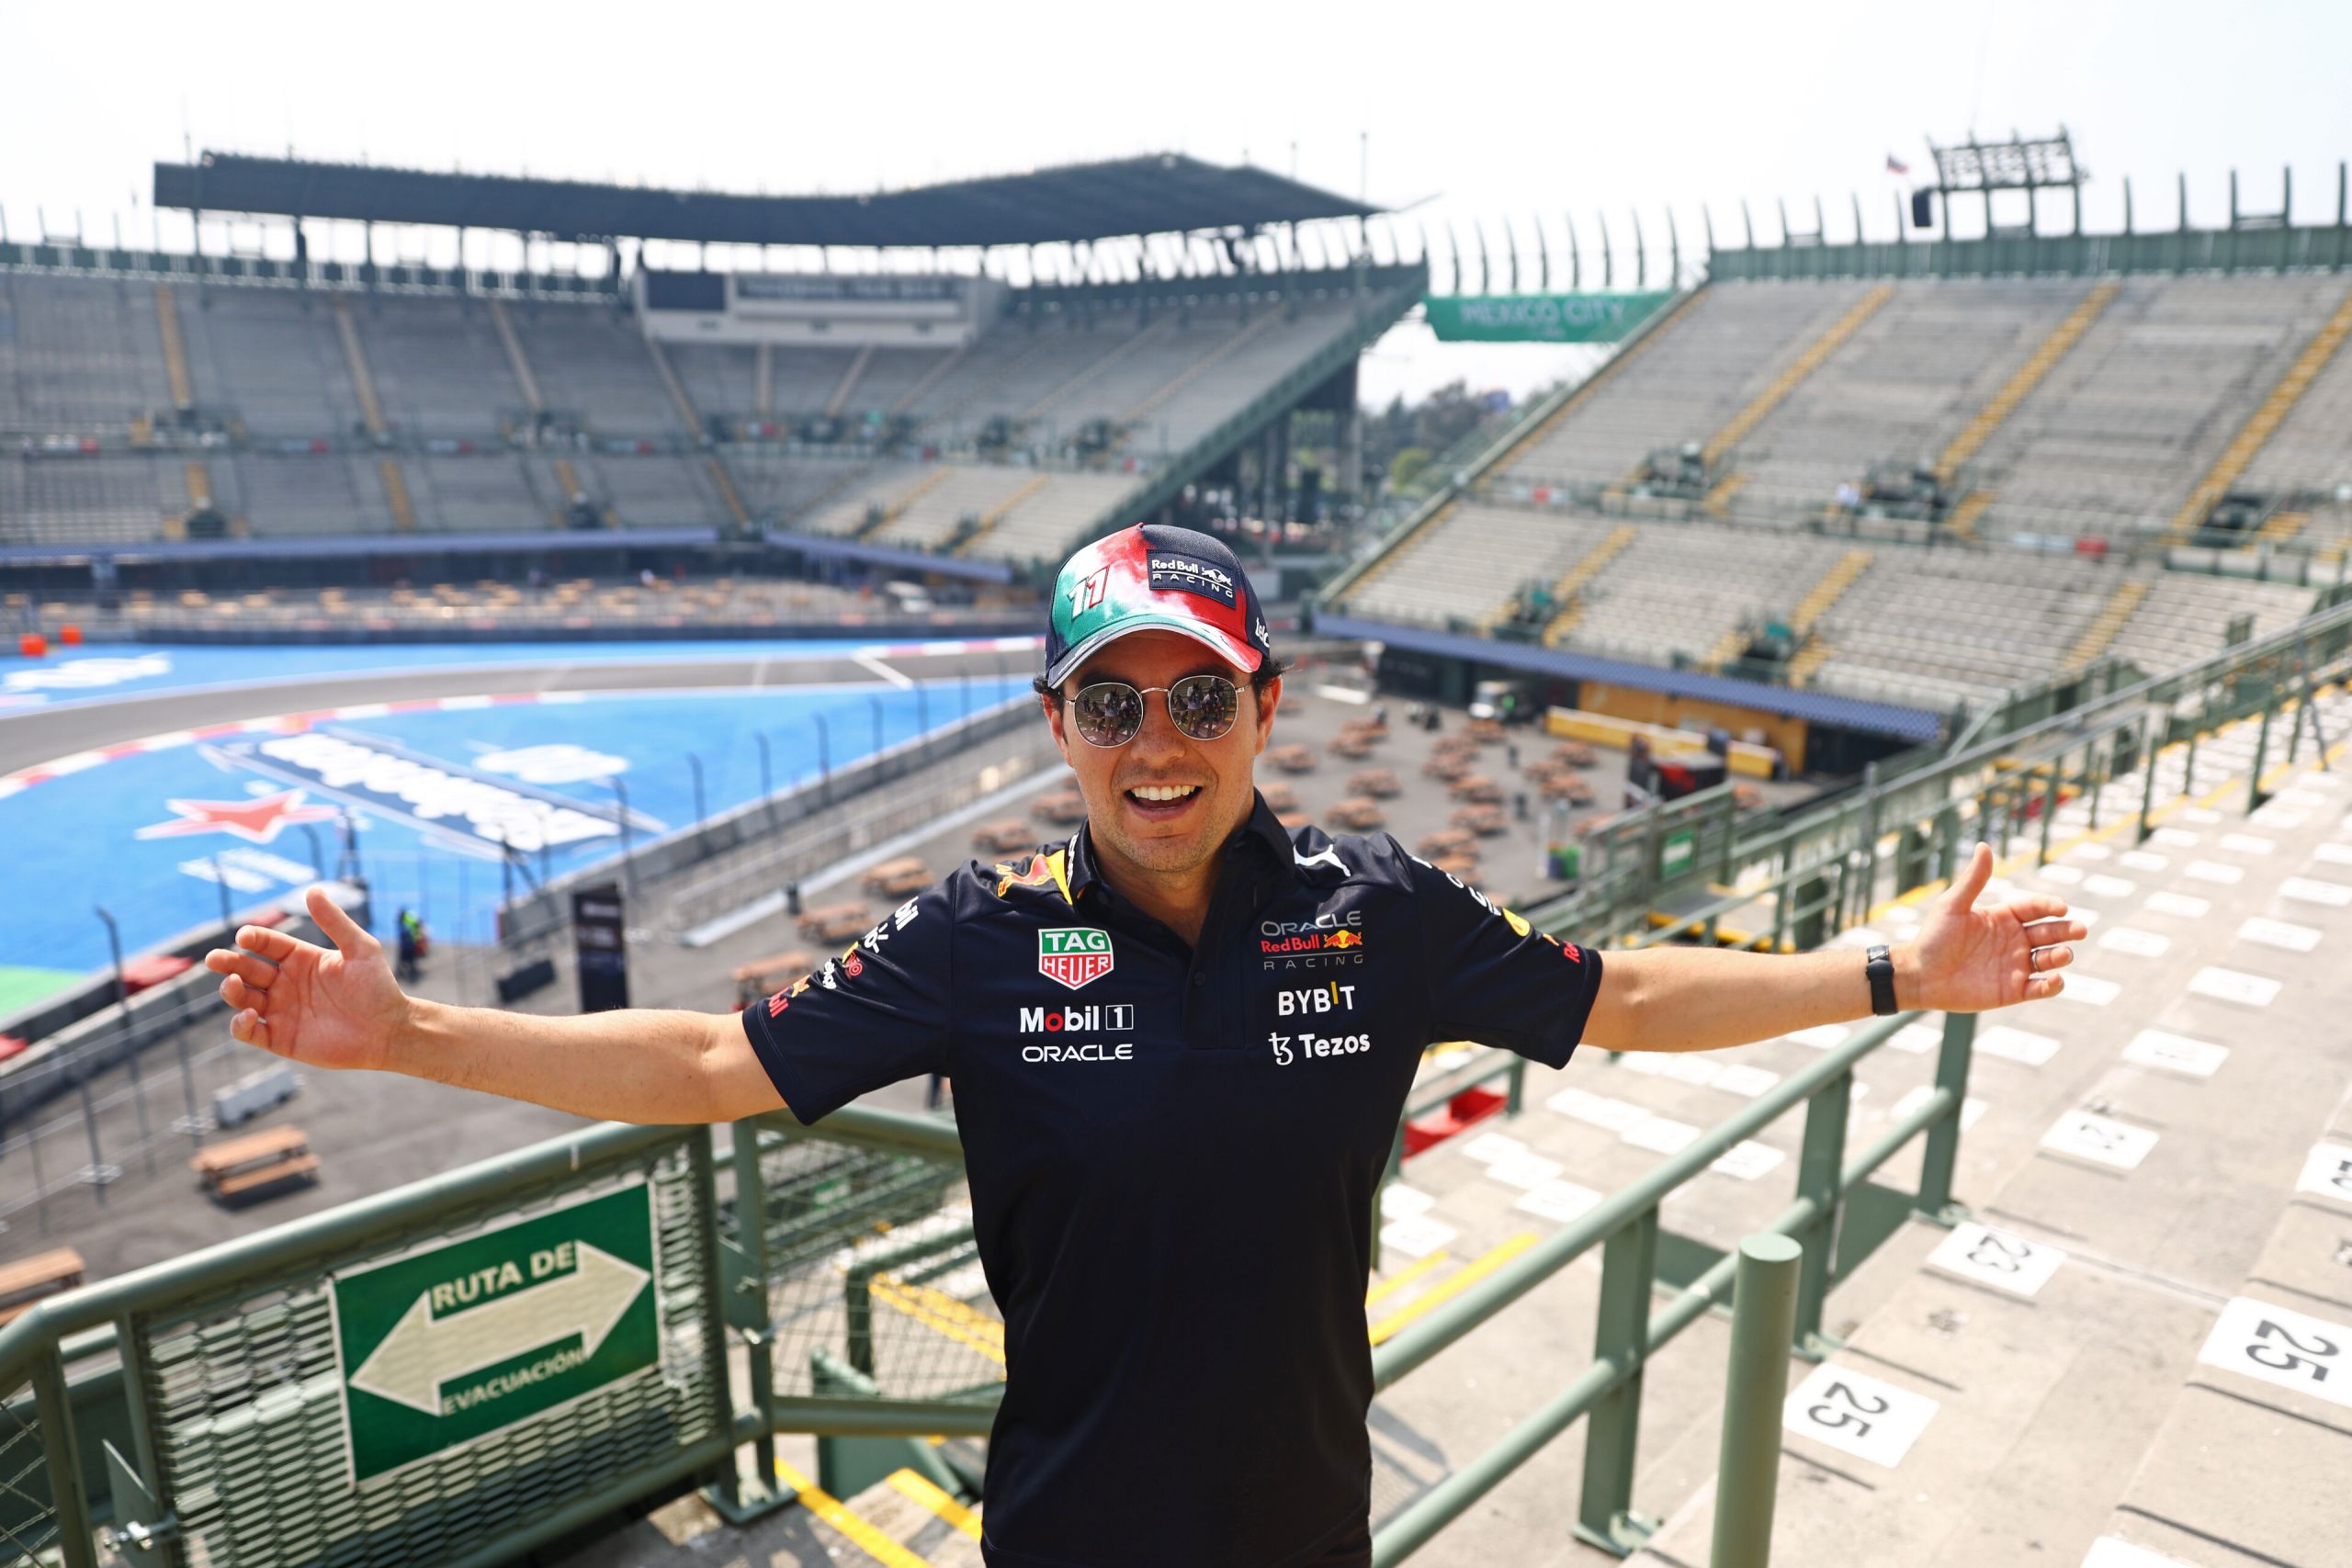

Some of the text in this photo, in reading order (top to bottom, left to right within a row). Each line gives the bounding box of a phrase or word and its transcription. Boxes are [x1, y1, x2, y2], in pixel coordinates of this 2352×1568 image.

[1461, 299, 1623, 323] MEXICO CITY
[1152, 559, 1198, 574] Red Bull
[1068, 565, 1110, 621] 11
[1152, 573, 1233, 598] RACING
[1255, 616, 1270, 648] telc
[894, 896, 919, 931] bil
[1261, 910, 1363, 936] ORACLE
[1045, 932, 1106, 952] TAG
[1261, 934, 1320, 953] Red Bull
[1044, 956, 1109, 985] HEUER
[1263, 954, 1363, 970] RACING
[1278, 981, 1355, 1016] BYBIT
[1020, 1006, 1100, 1033] Mobil
[1022, 1043, 1134, 1063] ORACLE
[1298, 1033, 1371, 1059] Tezos
[1966, 1234, 2032, 1273] 23
[431, 1240, 576, 1312] RUTA DE
[2245, 1319, 2341, 1382] 25
[441, 1348, 585, 1416] EVACUACIÓN
[1806, 1381, 1889, 1438] 25
